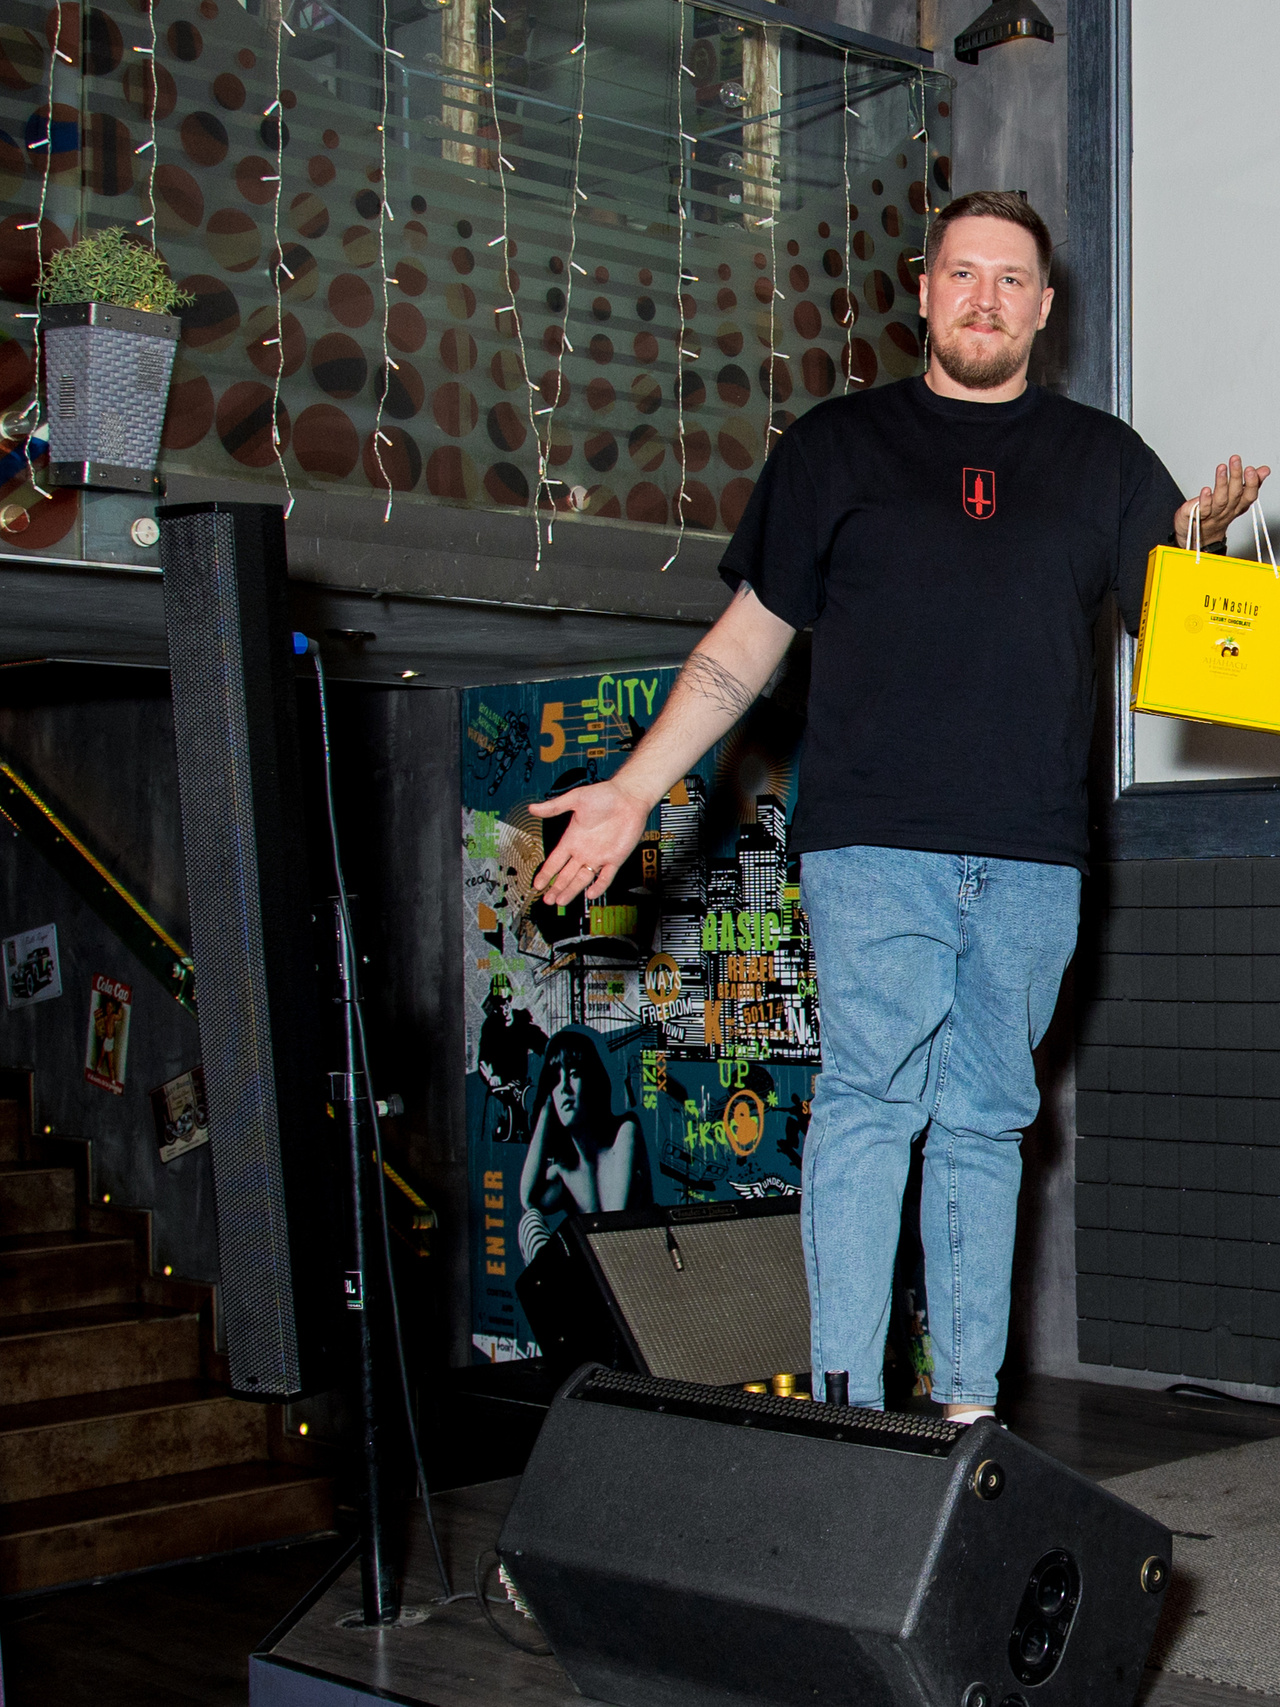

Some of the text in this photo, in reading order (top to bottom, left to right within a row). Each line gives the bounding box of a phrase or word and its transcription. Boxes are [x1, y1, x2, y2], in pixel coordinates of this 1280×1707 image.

[1204, 594, 1259, 616] Dy'Nastie
[1228, 618, 1251, 627] CHOCOLATE
[597, 675, 658, 717] CITY
[540, 702, 566, 763] 5
[702, 911, 780, 951] BASIC
[645, 971, 682, 990] WAYS
[728, 956, 776, 982] REBEL
[642, 997, 693, 1024] FREEDOM
[662, 1021, 685, 1040] TOWN
[642, 1050, 658, 1110] SIZE
[717, 1059, 750, 1088] UP
[762, 1176, 785, 1191] UNDER
[483, 1170, 506, 1276] ENTER
